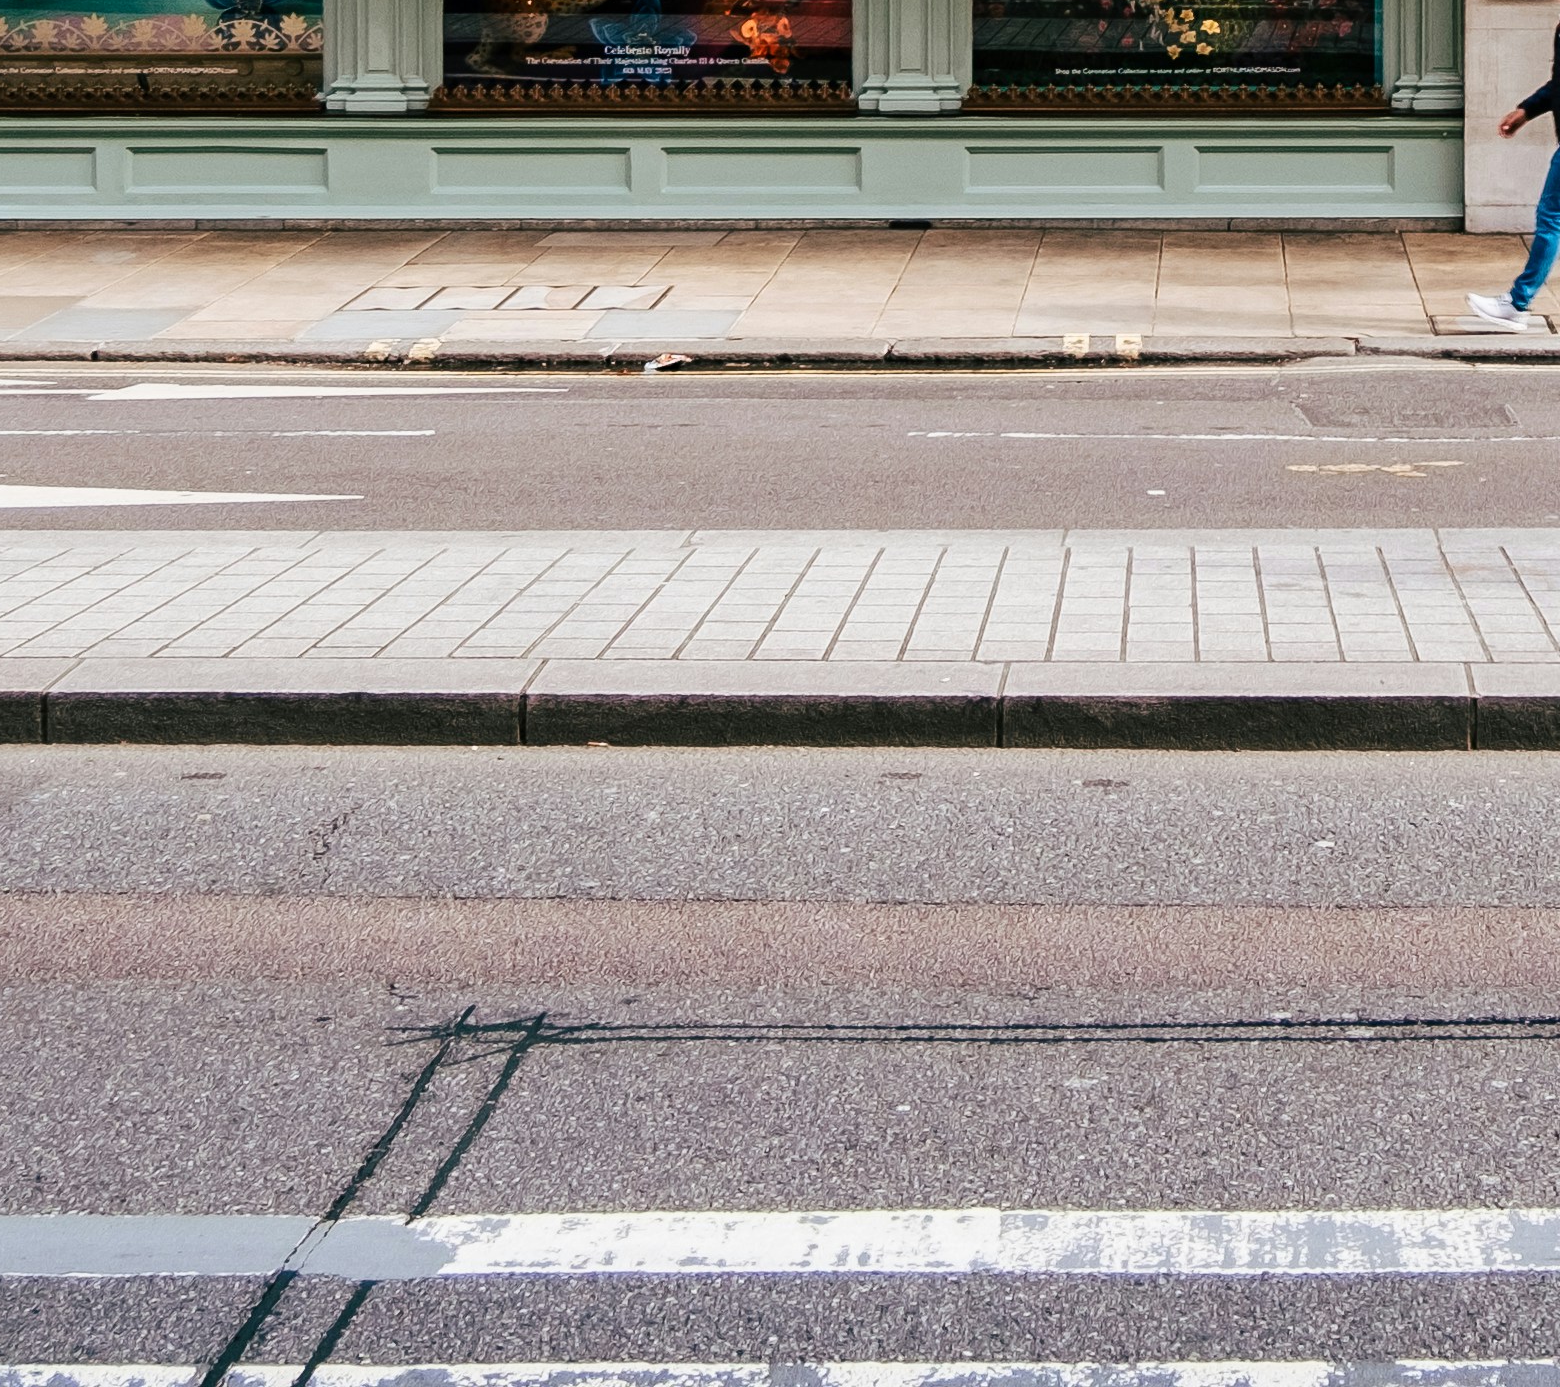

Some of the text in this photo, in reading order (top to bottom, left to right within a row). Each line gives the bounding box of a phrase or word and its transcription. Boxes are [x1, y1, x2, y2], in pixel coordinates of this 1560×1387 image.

[604, 45, 691, 56] Celebrate Royally
[526, 57, 540, 65] The
[542, 57, 581, 65] Coronation
